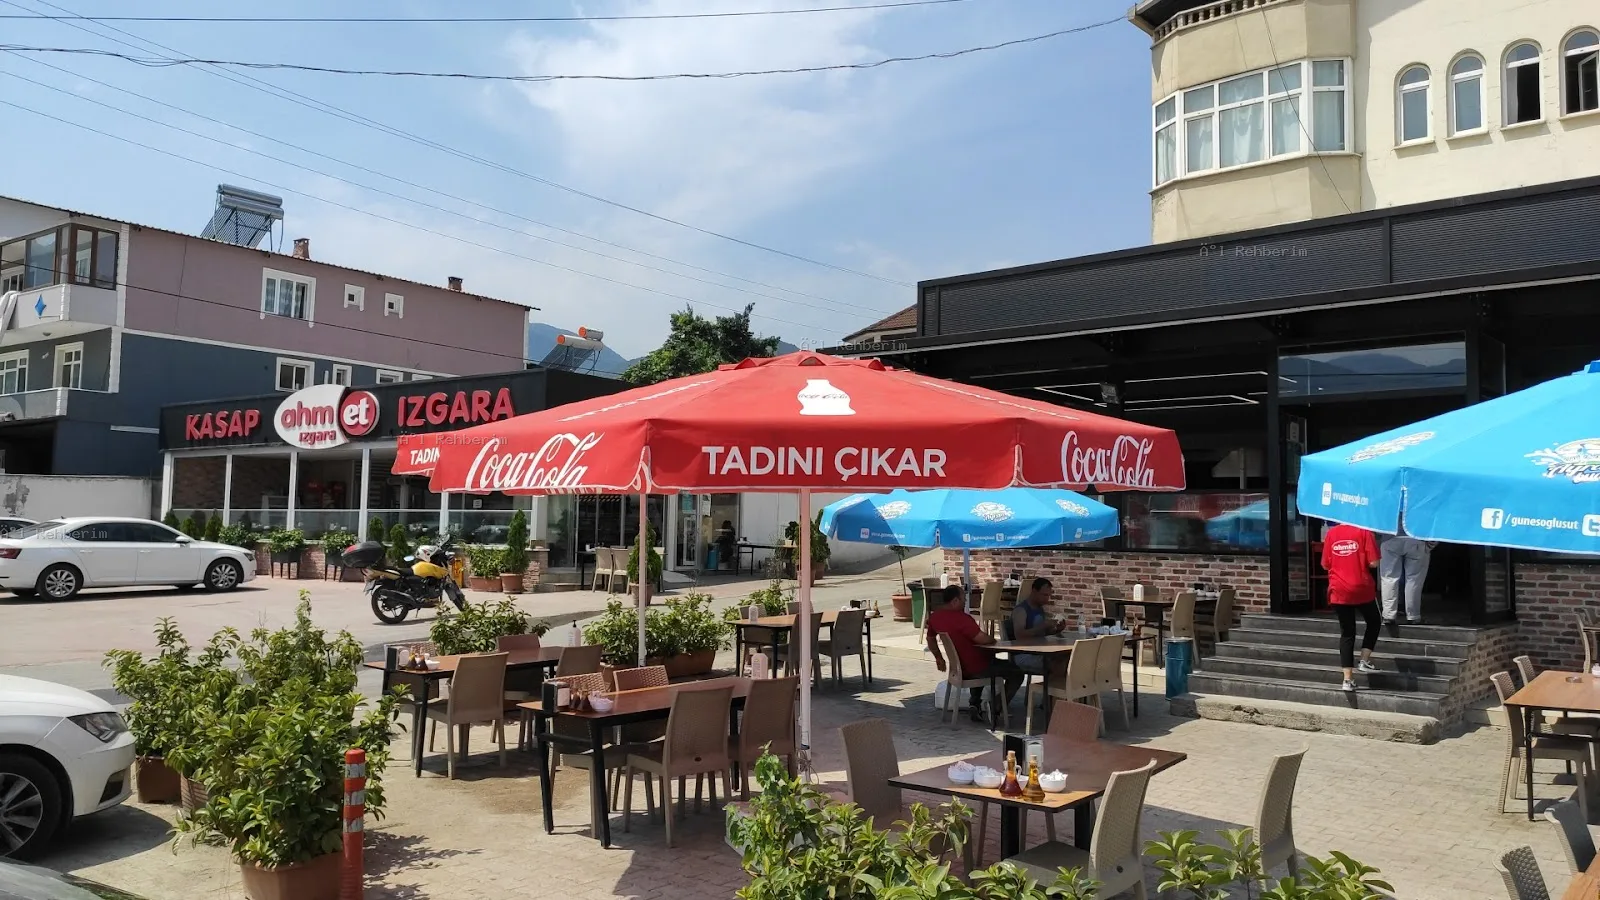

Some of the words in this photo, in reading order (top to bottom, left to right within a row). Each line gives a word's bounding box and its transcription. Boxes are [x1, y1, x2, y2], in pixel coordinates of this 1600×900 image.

[185, 409, 260, 440] KASAP
[397, 387, 516, 427] IZGARA
[465, 431, 605, 489] Coca-Cola
[701, 445, 823, 475] TADINI
[834, 446, 947, 482] ÇIKAR
[1060, 430, 1157, 487] Coca-Cola
